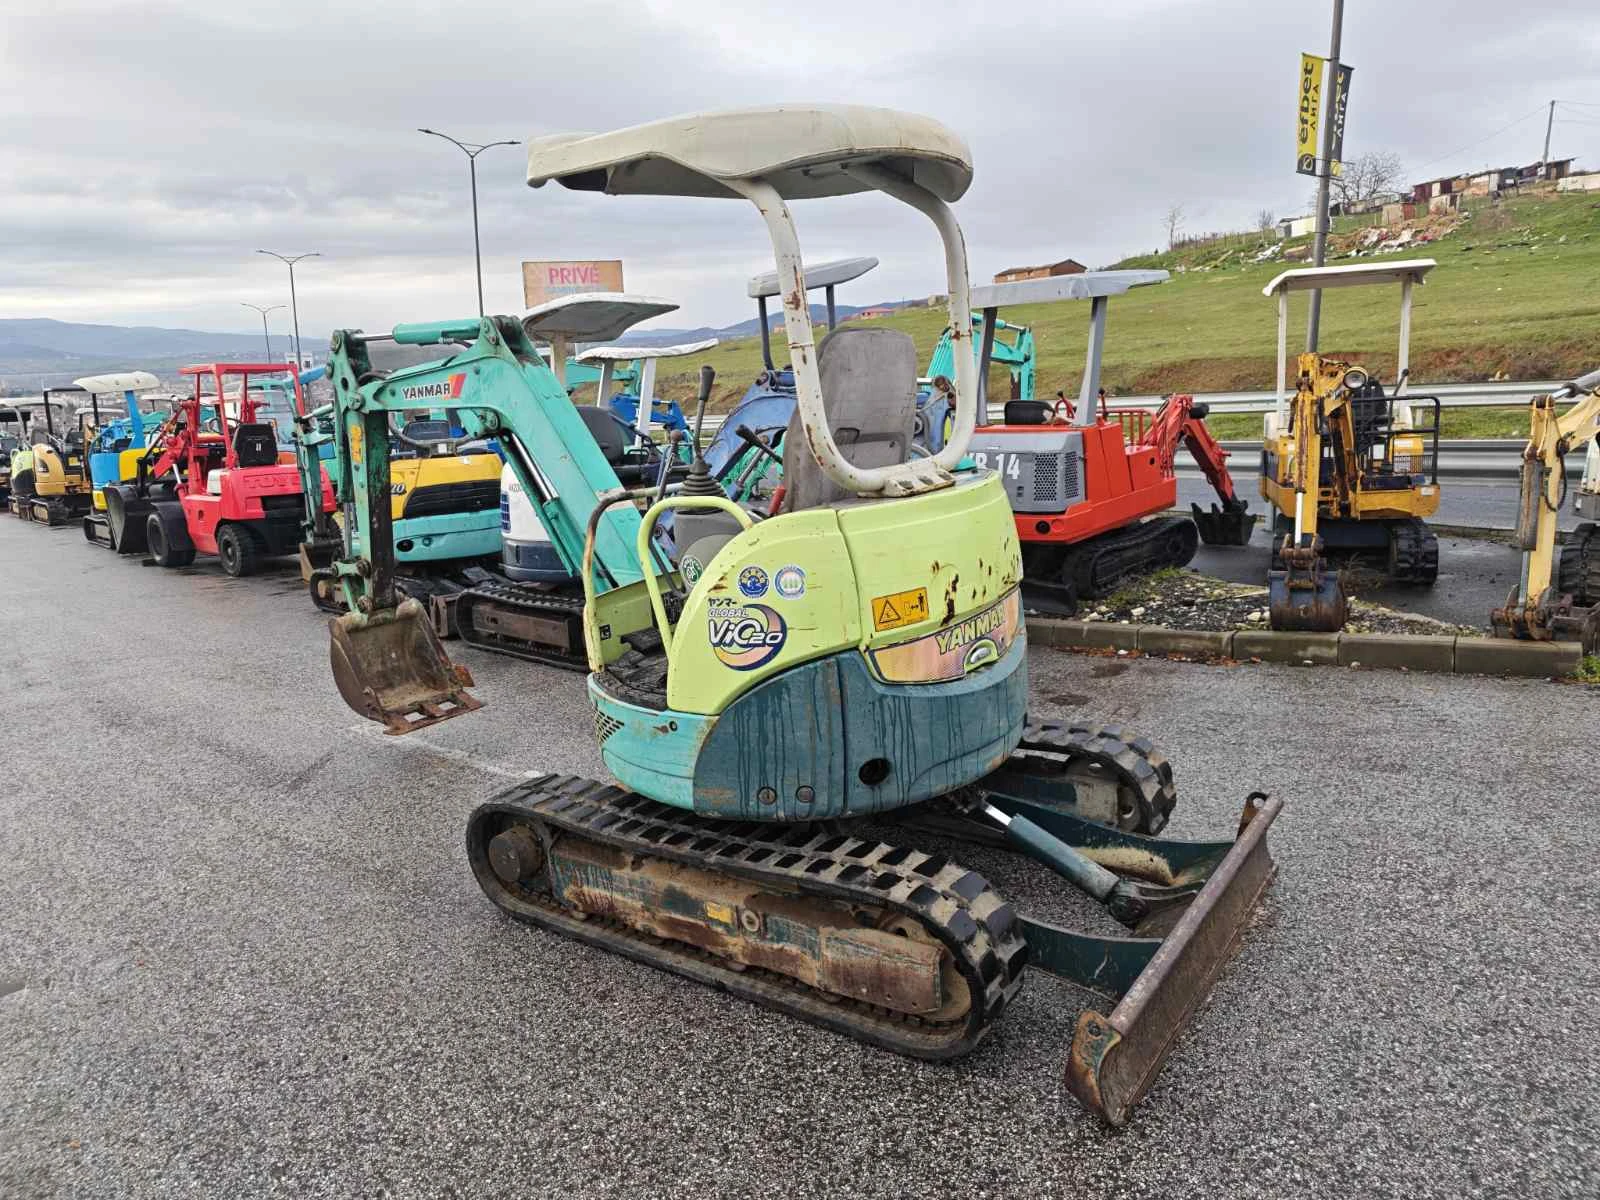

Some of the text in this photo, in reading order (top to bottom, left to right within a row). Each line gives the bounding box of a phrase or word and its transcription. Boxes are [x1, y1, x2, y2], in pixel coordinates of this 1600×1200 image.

[1299, 62, 1314, 144] efbet
[402, 382, 451, 399] YANMAR
[995, 453, 1020, 480] 14
[708, 607, 749, 618] GLOBAL
